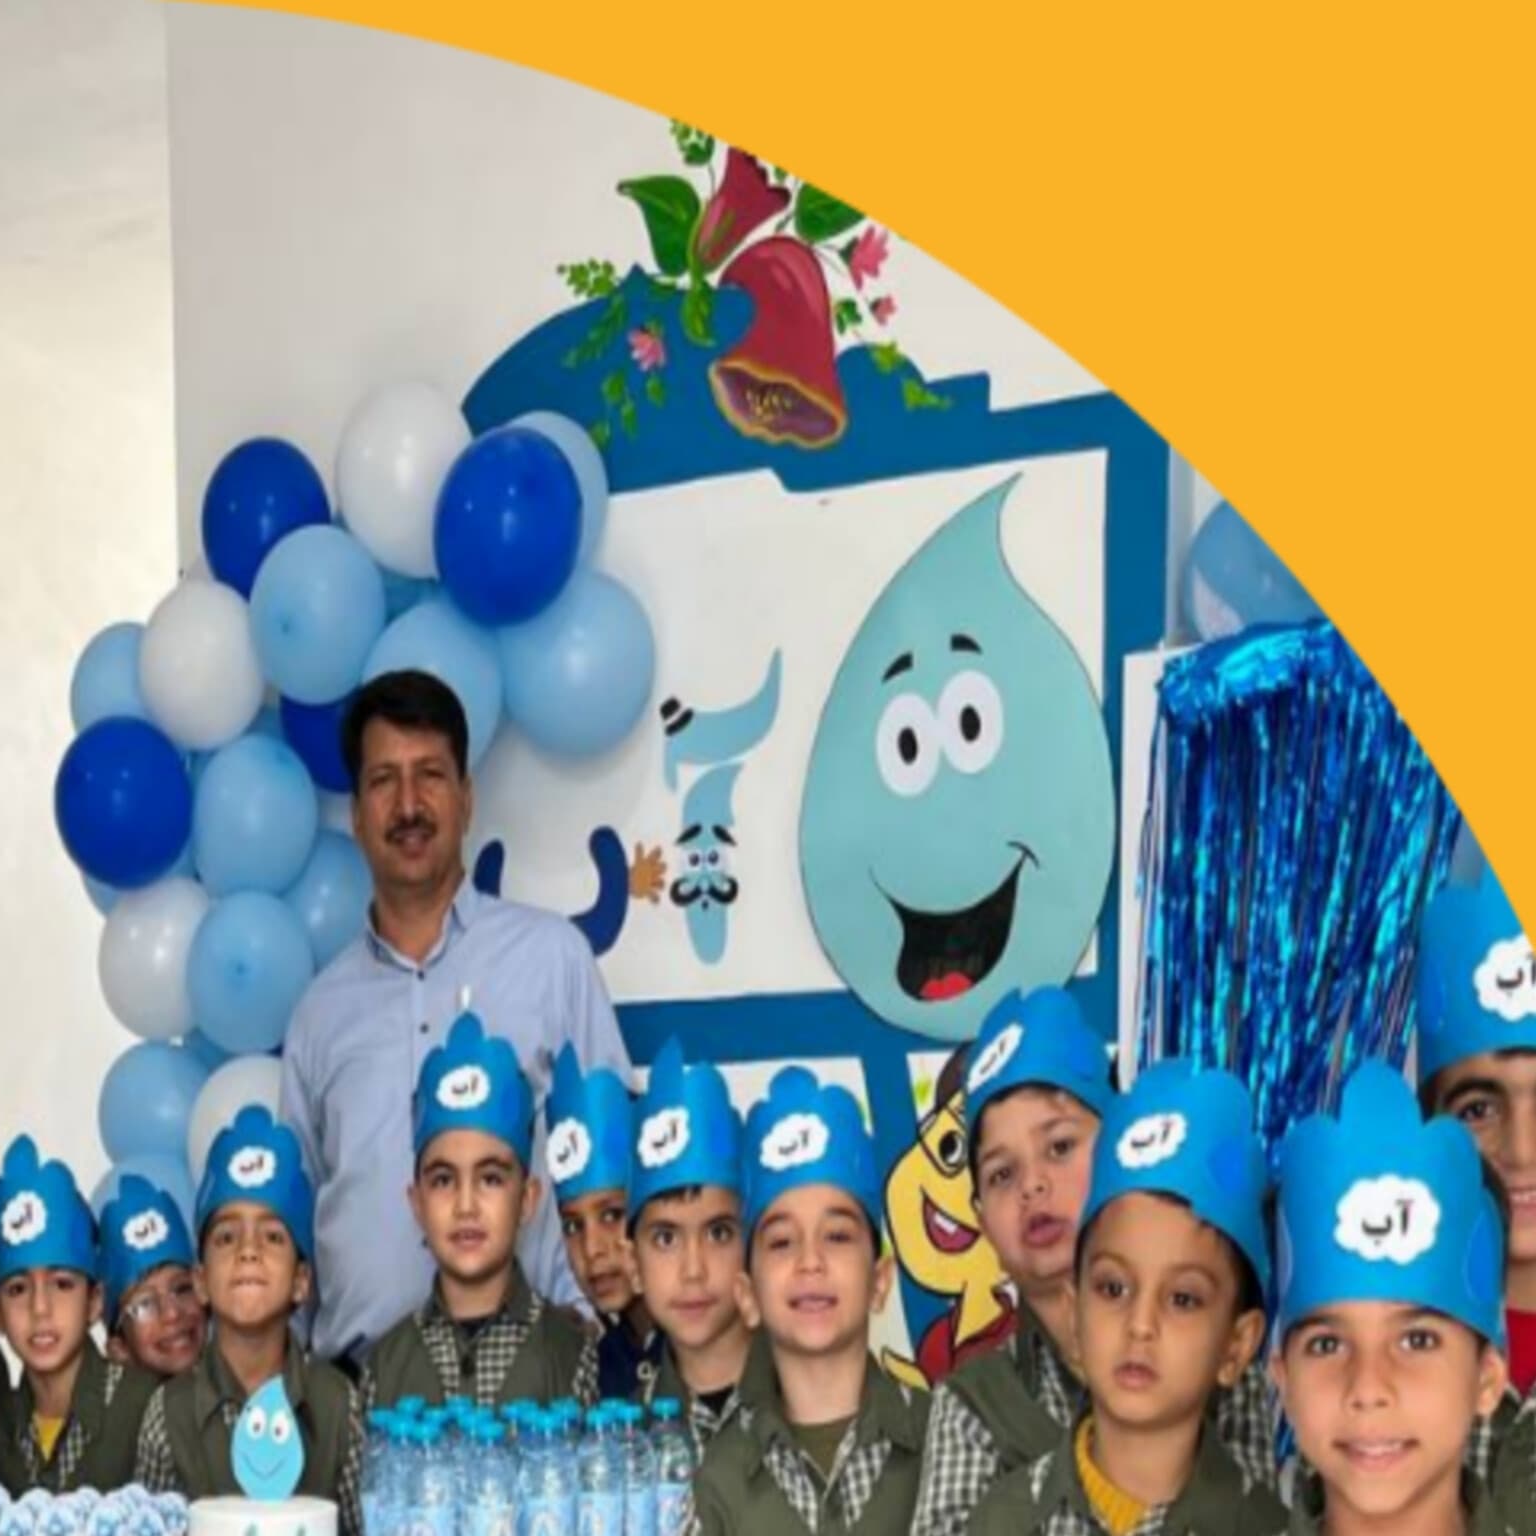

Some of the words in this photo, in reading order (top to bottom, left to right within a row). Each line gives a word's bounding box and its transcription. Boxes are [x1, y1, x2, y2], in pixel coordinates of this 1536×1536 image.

[777, 1128, 811, 1158] آب
[1130, 1121, 1173, 1152] آب
[1362, 1199, 1414, 1246] آب
